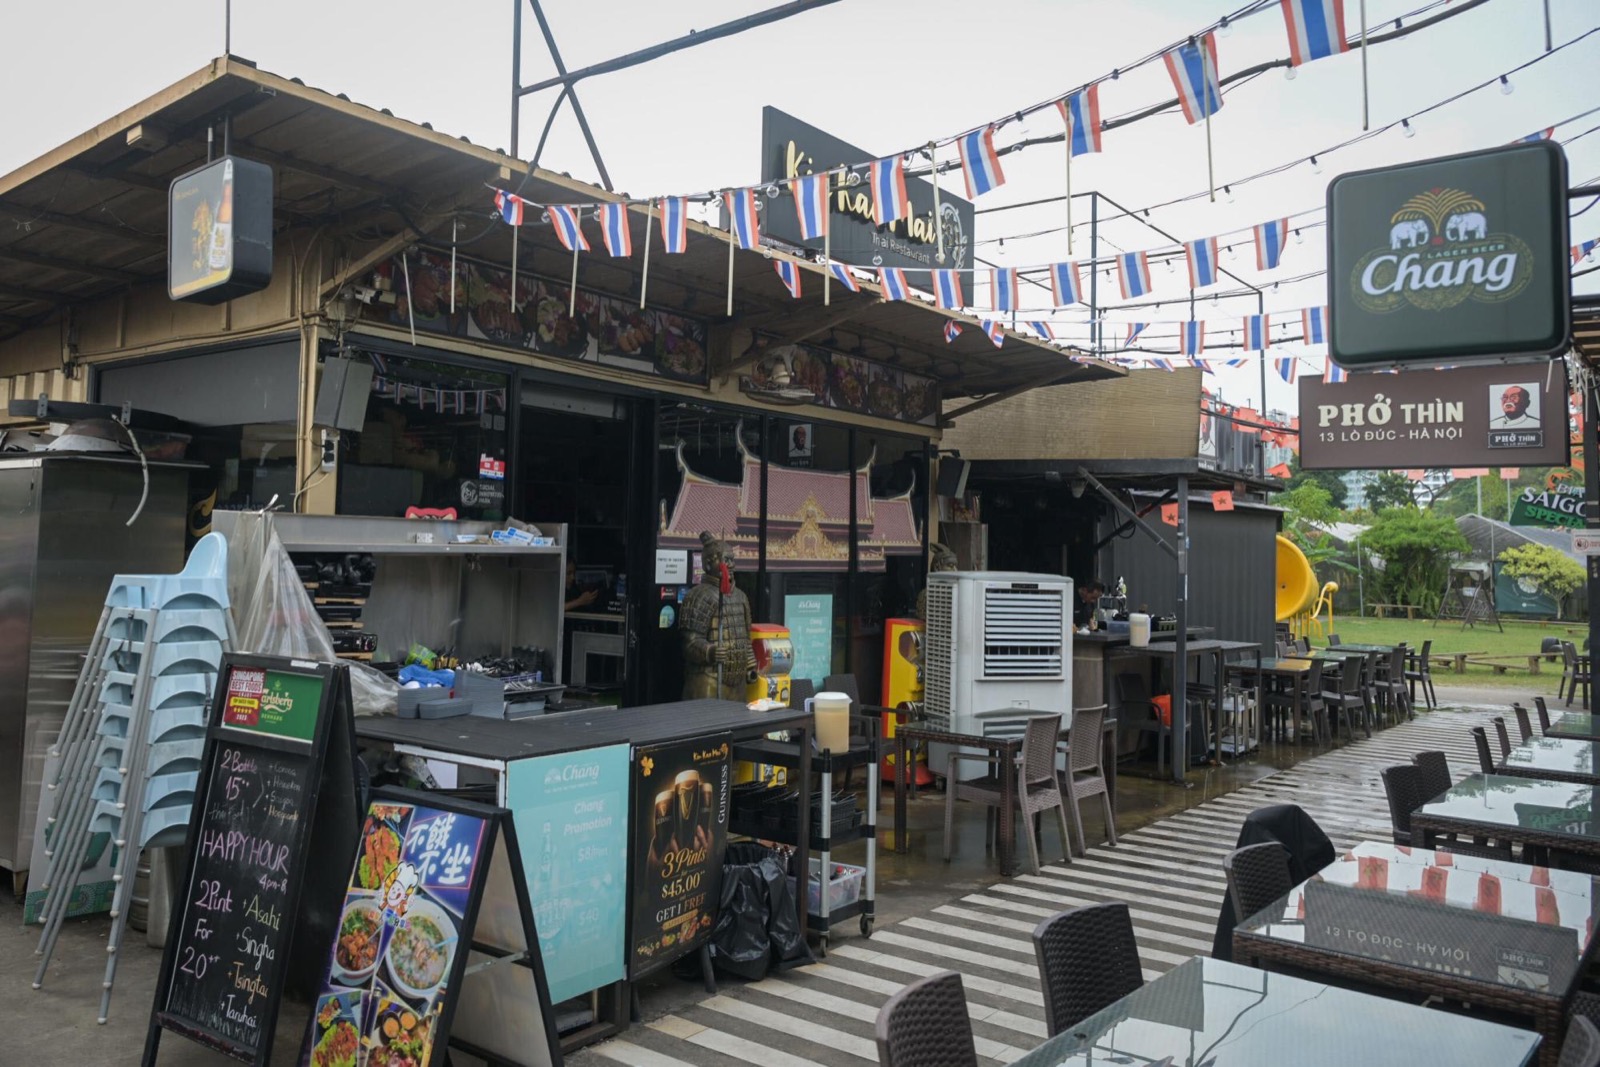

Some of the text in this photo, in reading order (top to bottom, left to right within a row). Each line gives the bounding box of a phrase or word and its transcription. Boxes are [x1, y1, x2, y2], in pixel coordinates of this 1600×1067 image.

[871, 231, 930, 265] Thai Restaurant
[1426, 243, 1505, 260] LAGER BEER
[1361, 251, 1518, 297] Chang
[1317, 393, 1464, 428] PHỞ THÌN
[1318, 432, 1335, 442] 13
[1341, 429, 1361, 442] LÒ
[1364, 428, 1397, 441] ĐÚC
[1409, 427, 1430, 440] HÀ
[1434, 426, 1463, 441] NỘI
[1521, 486, 1587, 518] SAIGO
[1524, 504, 1586, 529] SPECIA
[232, 670, 265, 682] SINGAPORE
[260, 688, 294, 711] arlsberg
[562, 764, 600, 781] Chang
[717, 763, 728, 824] GUINNESS
[563, 816, 612, 837] Promotion
[201, 829, 289, 875] HAPPY HOUR
[661, 846, 707, 878] 3 Pints
[656, 905, 677, 923] GET
[194, 918, 214, 940] For
